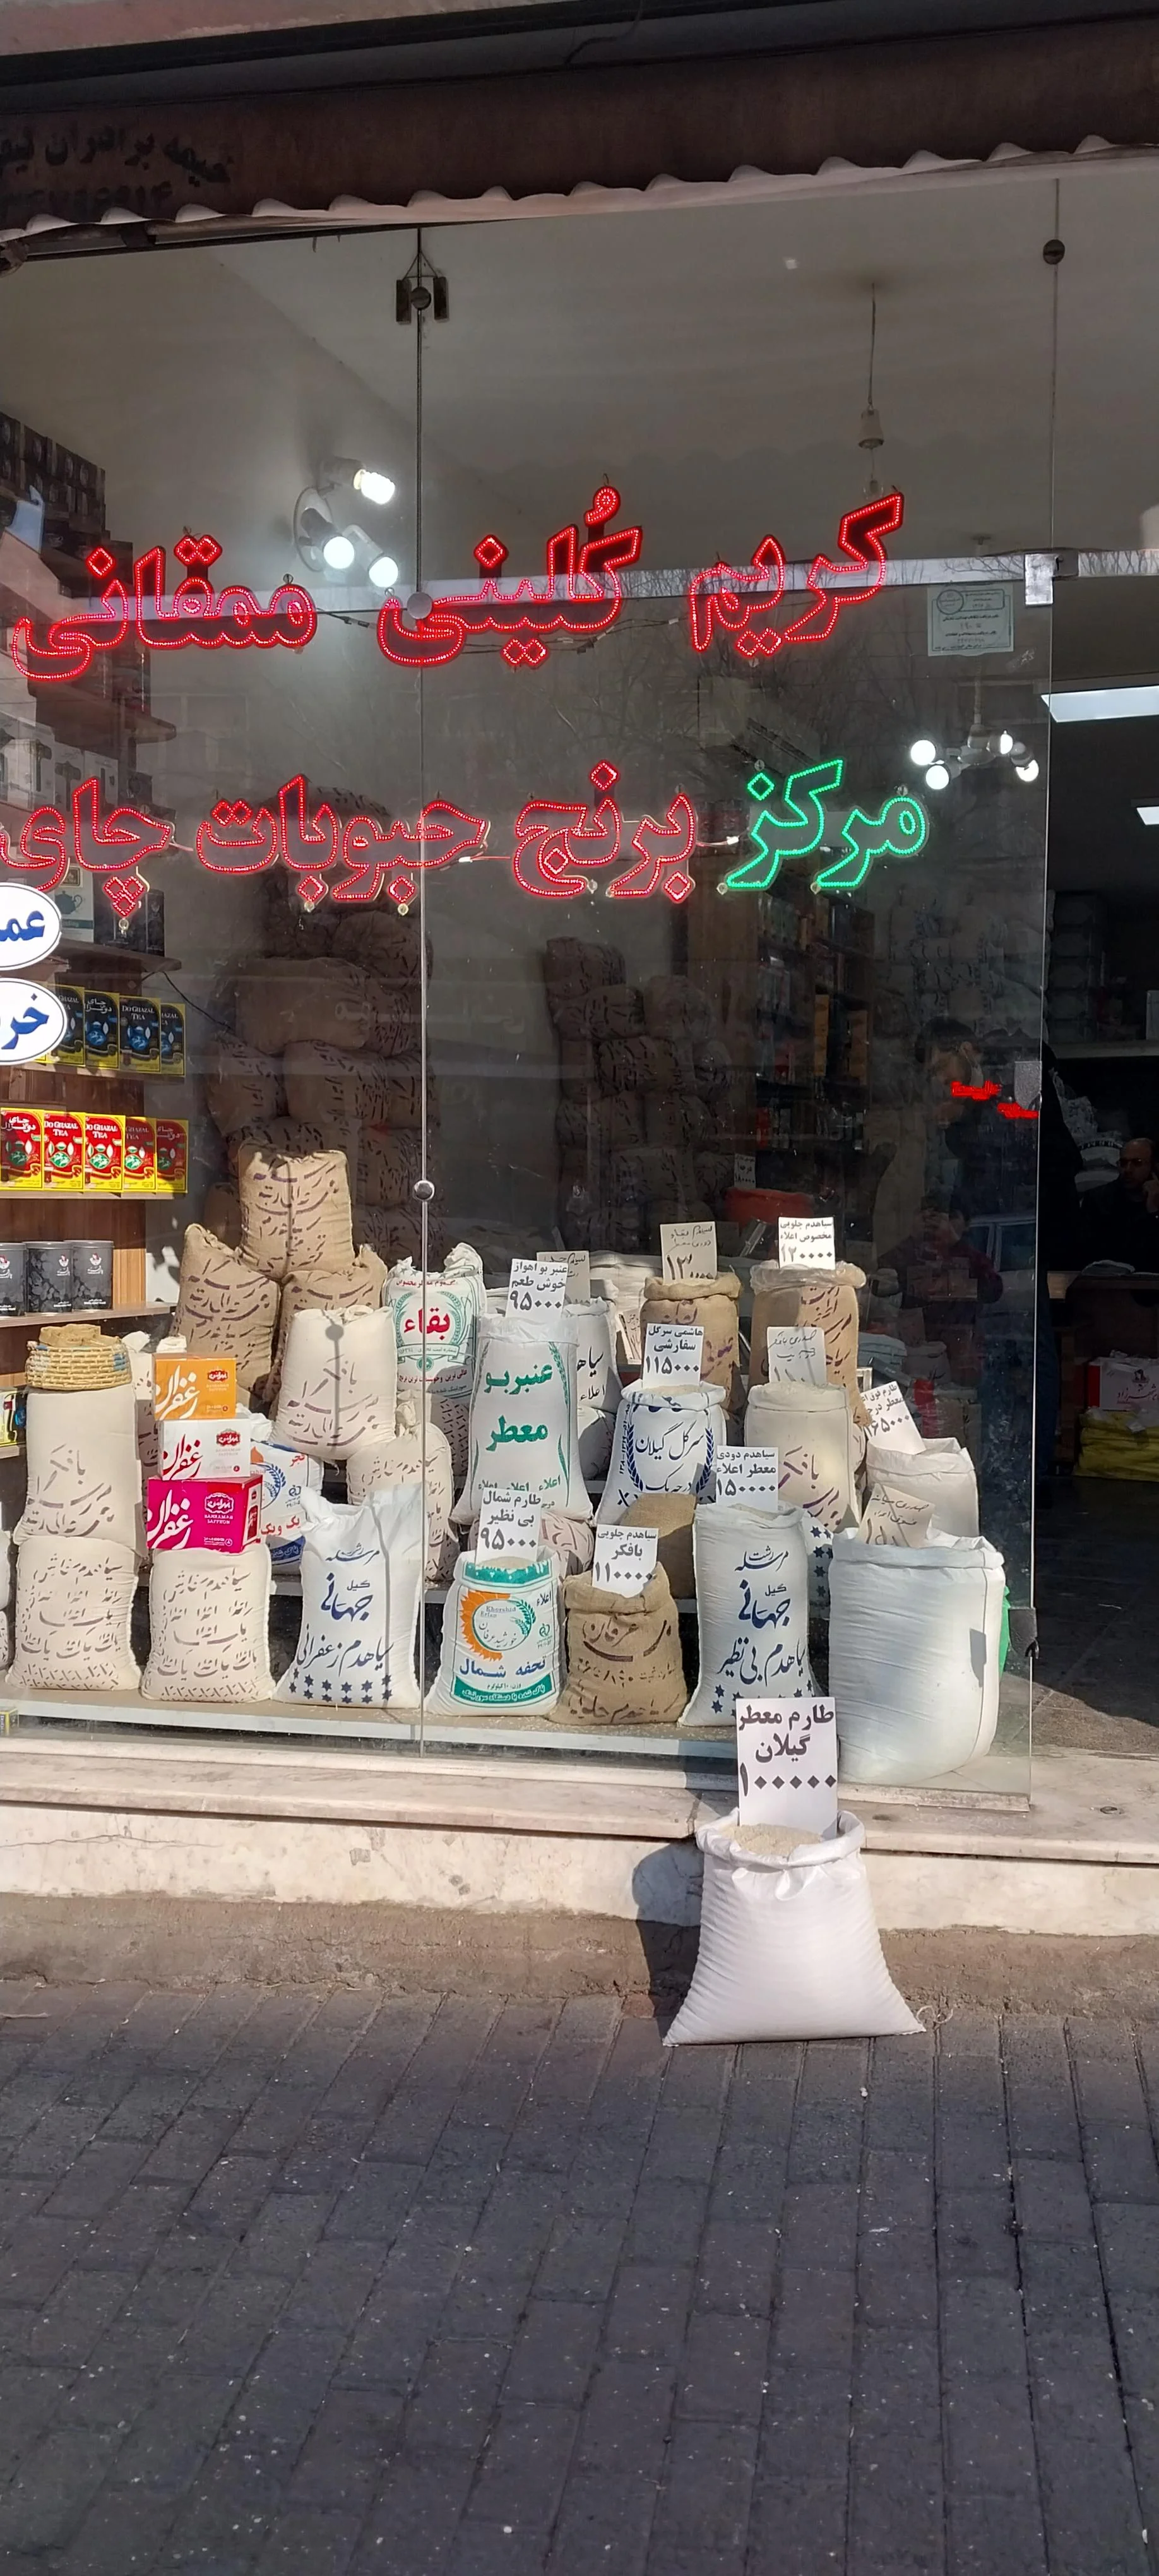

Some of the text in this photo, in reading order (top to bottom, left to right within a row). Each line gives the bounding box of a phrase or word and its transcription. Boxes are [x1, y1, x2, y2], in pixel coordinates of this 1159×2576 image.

[689, 492, 903, 655] کریم
[13, 535, 317, 681] ممقانی
[0, 760, 926, 917] مرکز برنج حبوبات چای
[0, 910, 45, 941] عم
[0, 993, 49, 1049] خر
[131, 1013, 146, 1021] TEA
[53, 1128, 68, 1136] TEA
[54, 1121, 78, 1130] GHAZAL
[93, 1124, 118, 1132] GHAZAL
[93, 1131, 107, 1139] TEA
[805, 1219, 832, 1230] سیاهدم
[799, 1231, 832, 1243] مخصوص
[781, 1243, 832, 1263] ۱۲۰۰۰۰
[513, 1261, 537, 1273] اهواز
[550, 1265, 567, 1275] عنبر
[512, 1275, 566, 1292] خوش طعم
[509, 1290, 562, 1311] ۹۵۰۰۰
[404, 1308, 450, 1340] بقاء
[674, 1327, 703, 1338] هاشمی
[653, 1338, 696, 1354] سفارشی
[576, 1345, 603, 1377] سیاه
[646, 1356, 699, 1374] ۱۱۵۰۰۰
[867, 1404, 883, 1415] درج
[486, 1415, 549, 1452] معطر
[635, 1421, 684, 1460] گیلان
[716, 1450, 775, 1460] سیاهدم دودی
[716, 1462, 776, 1478] معطر اعلاء
[717, 1479, 776, 1496] ۱۵۰۰۰۰
[483, 1491, 542, 1508] طارم شمال
[487, 1508, 535, 1527] بی نظیر
[480, 1527, 537, 1550] ۹۵۰۰۰
[627, 1530, 657, 1541] سیاهدم
[611, 1542, 643, 1561] بافکر
[595, 1561, 653, 1583] ۱۱۰۰۰۰
[338, 1636, 394, 1677] سیاهدم
[515, 1655, 547, 1677] تحفه
[460, 1658, 506, 1679] شمال
[739, 1704, 834, 1731] طارم معطر
[755, 1732, 811, 1763] گیلان
[740, 1762, 837, 1798] ۱۰۰۰۰۰
